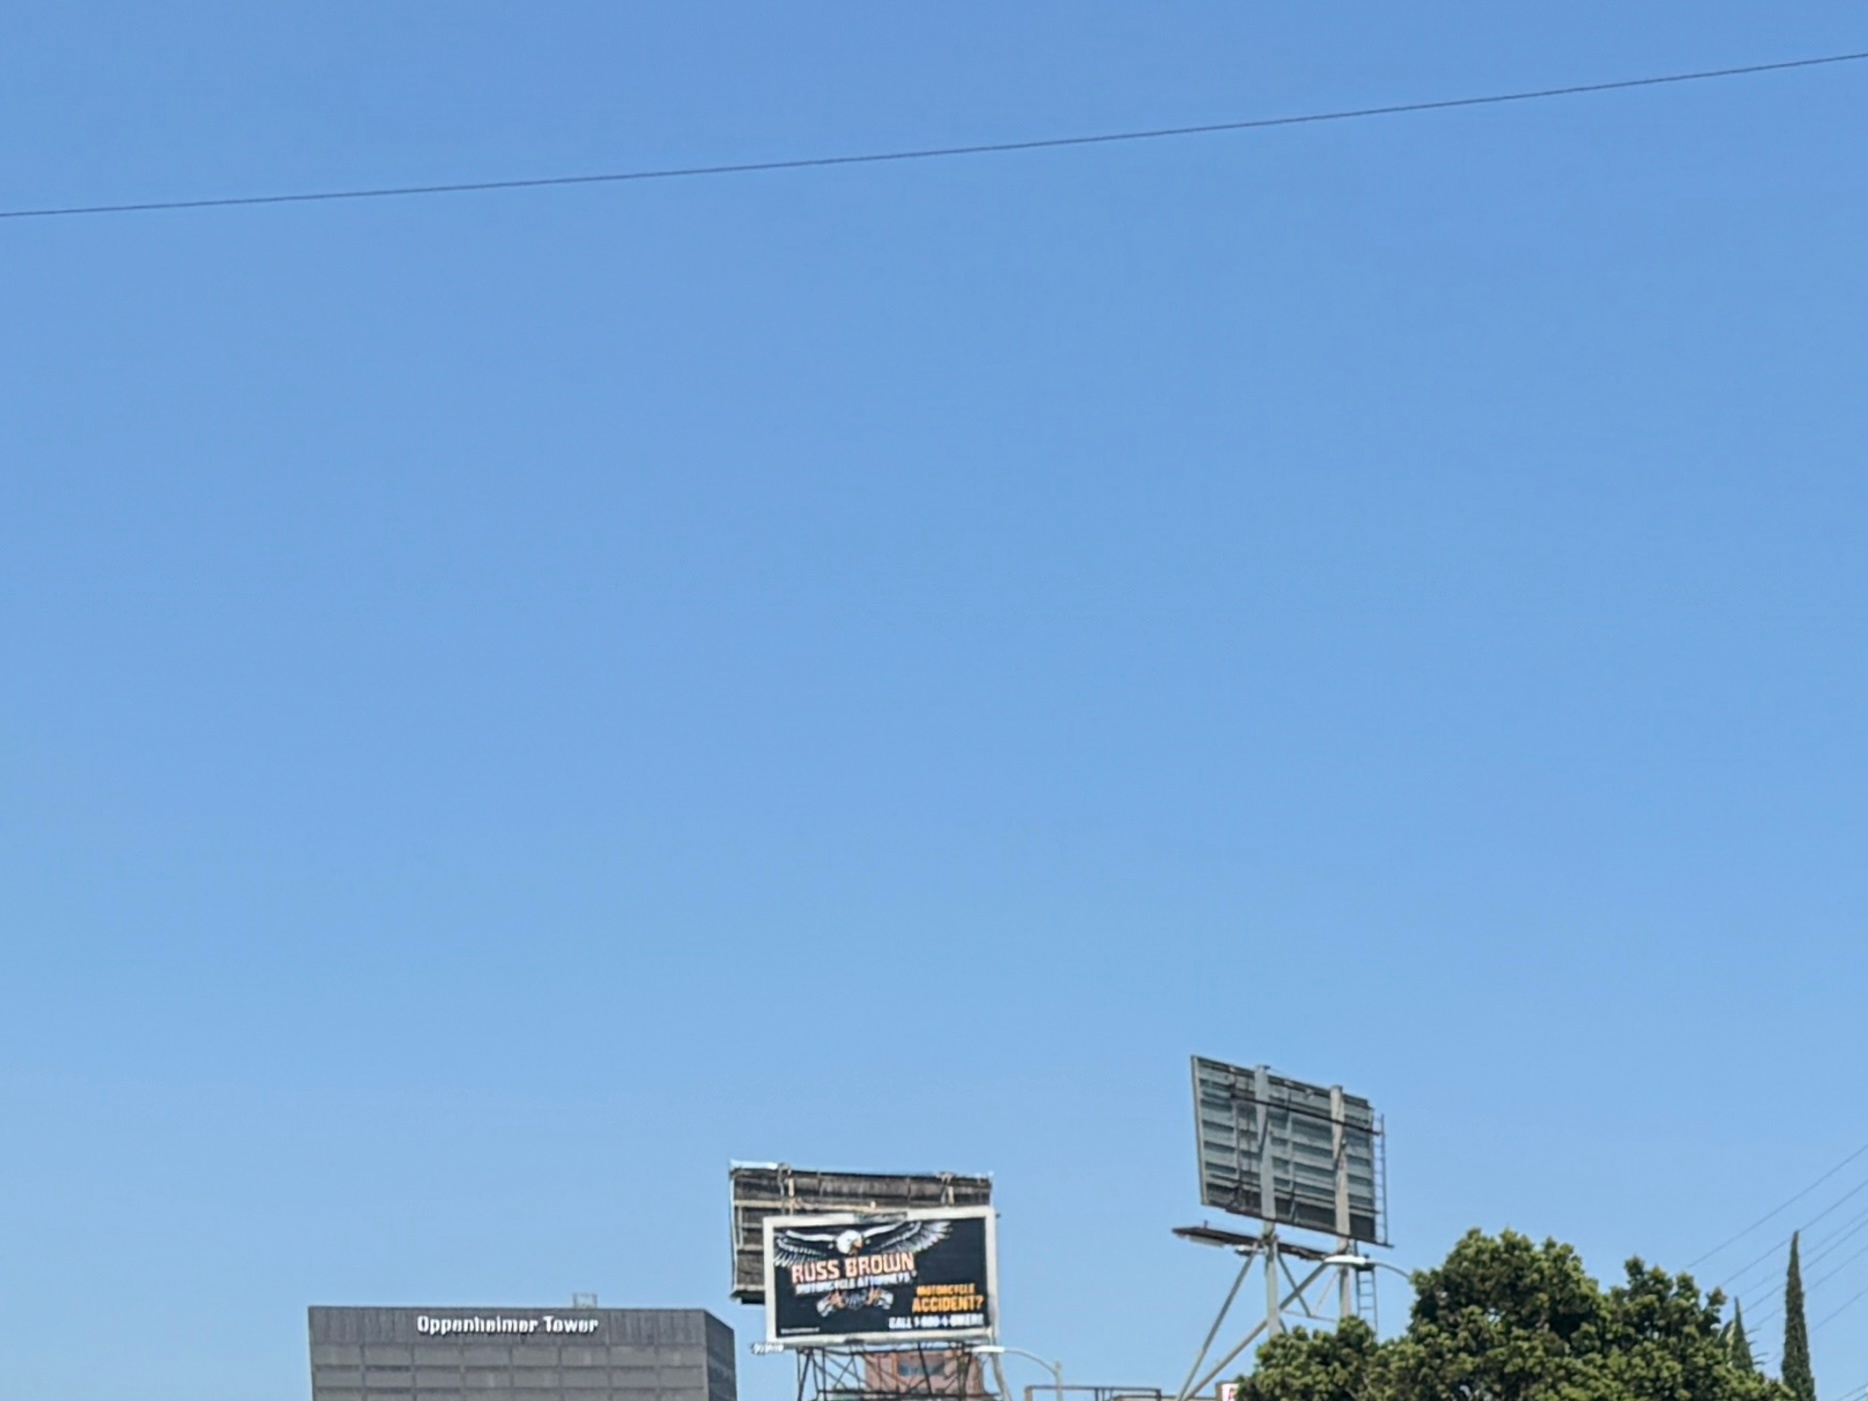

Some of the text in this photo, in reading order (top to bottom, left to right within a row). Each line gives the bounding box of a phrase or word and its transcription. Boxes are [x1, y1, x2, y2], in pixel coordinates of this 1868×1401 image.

[791, 1252, 915, 1284] RUSS BROWN
[912, 1295, 984, 1313] ACCIDENT?
[417, 1315, 599, 1335] Oppenheimer Tower
[889, 1316, 912, 1329] CALL
